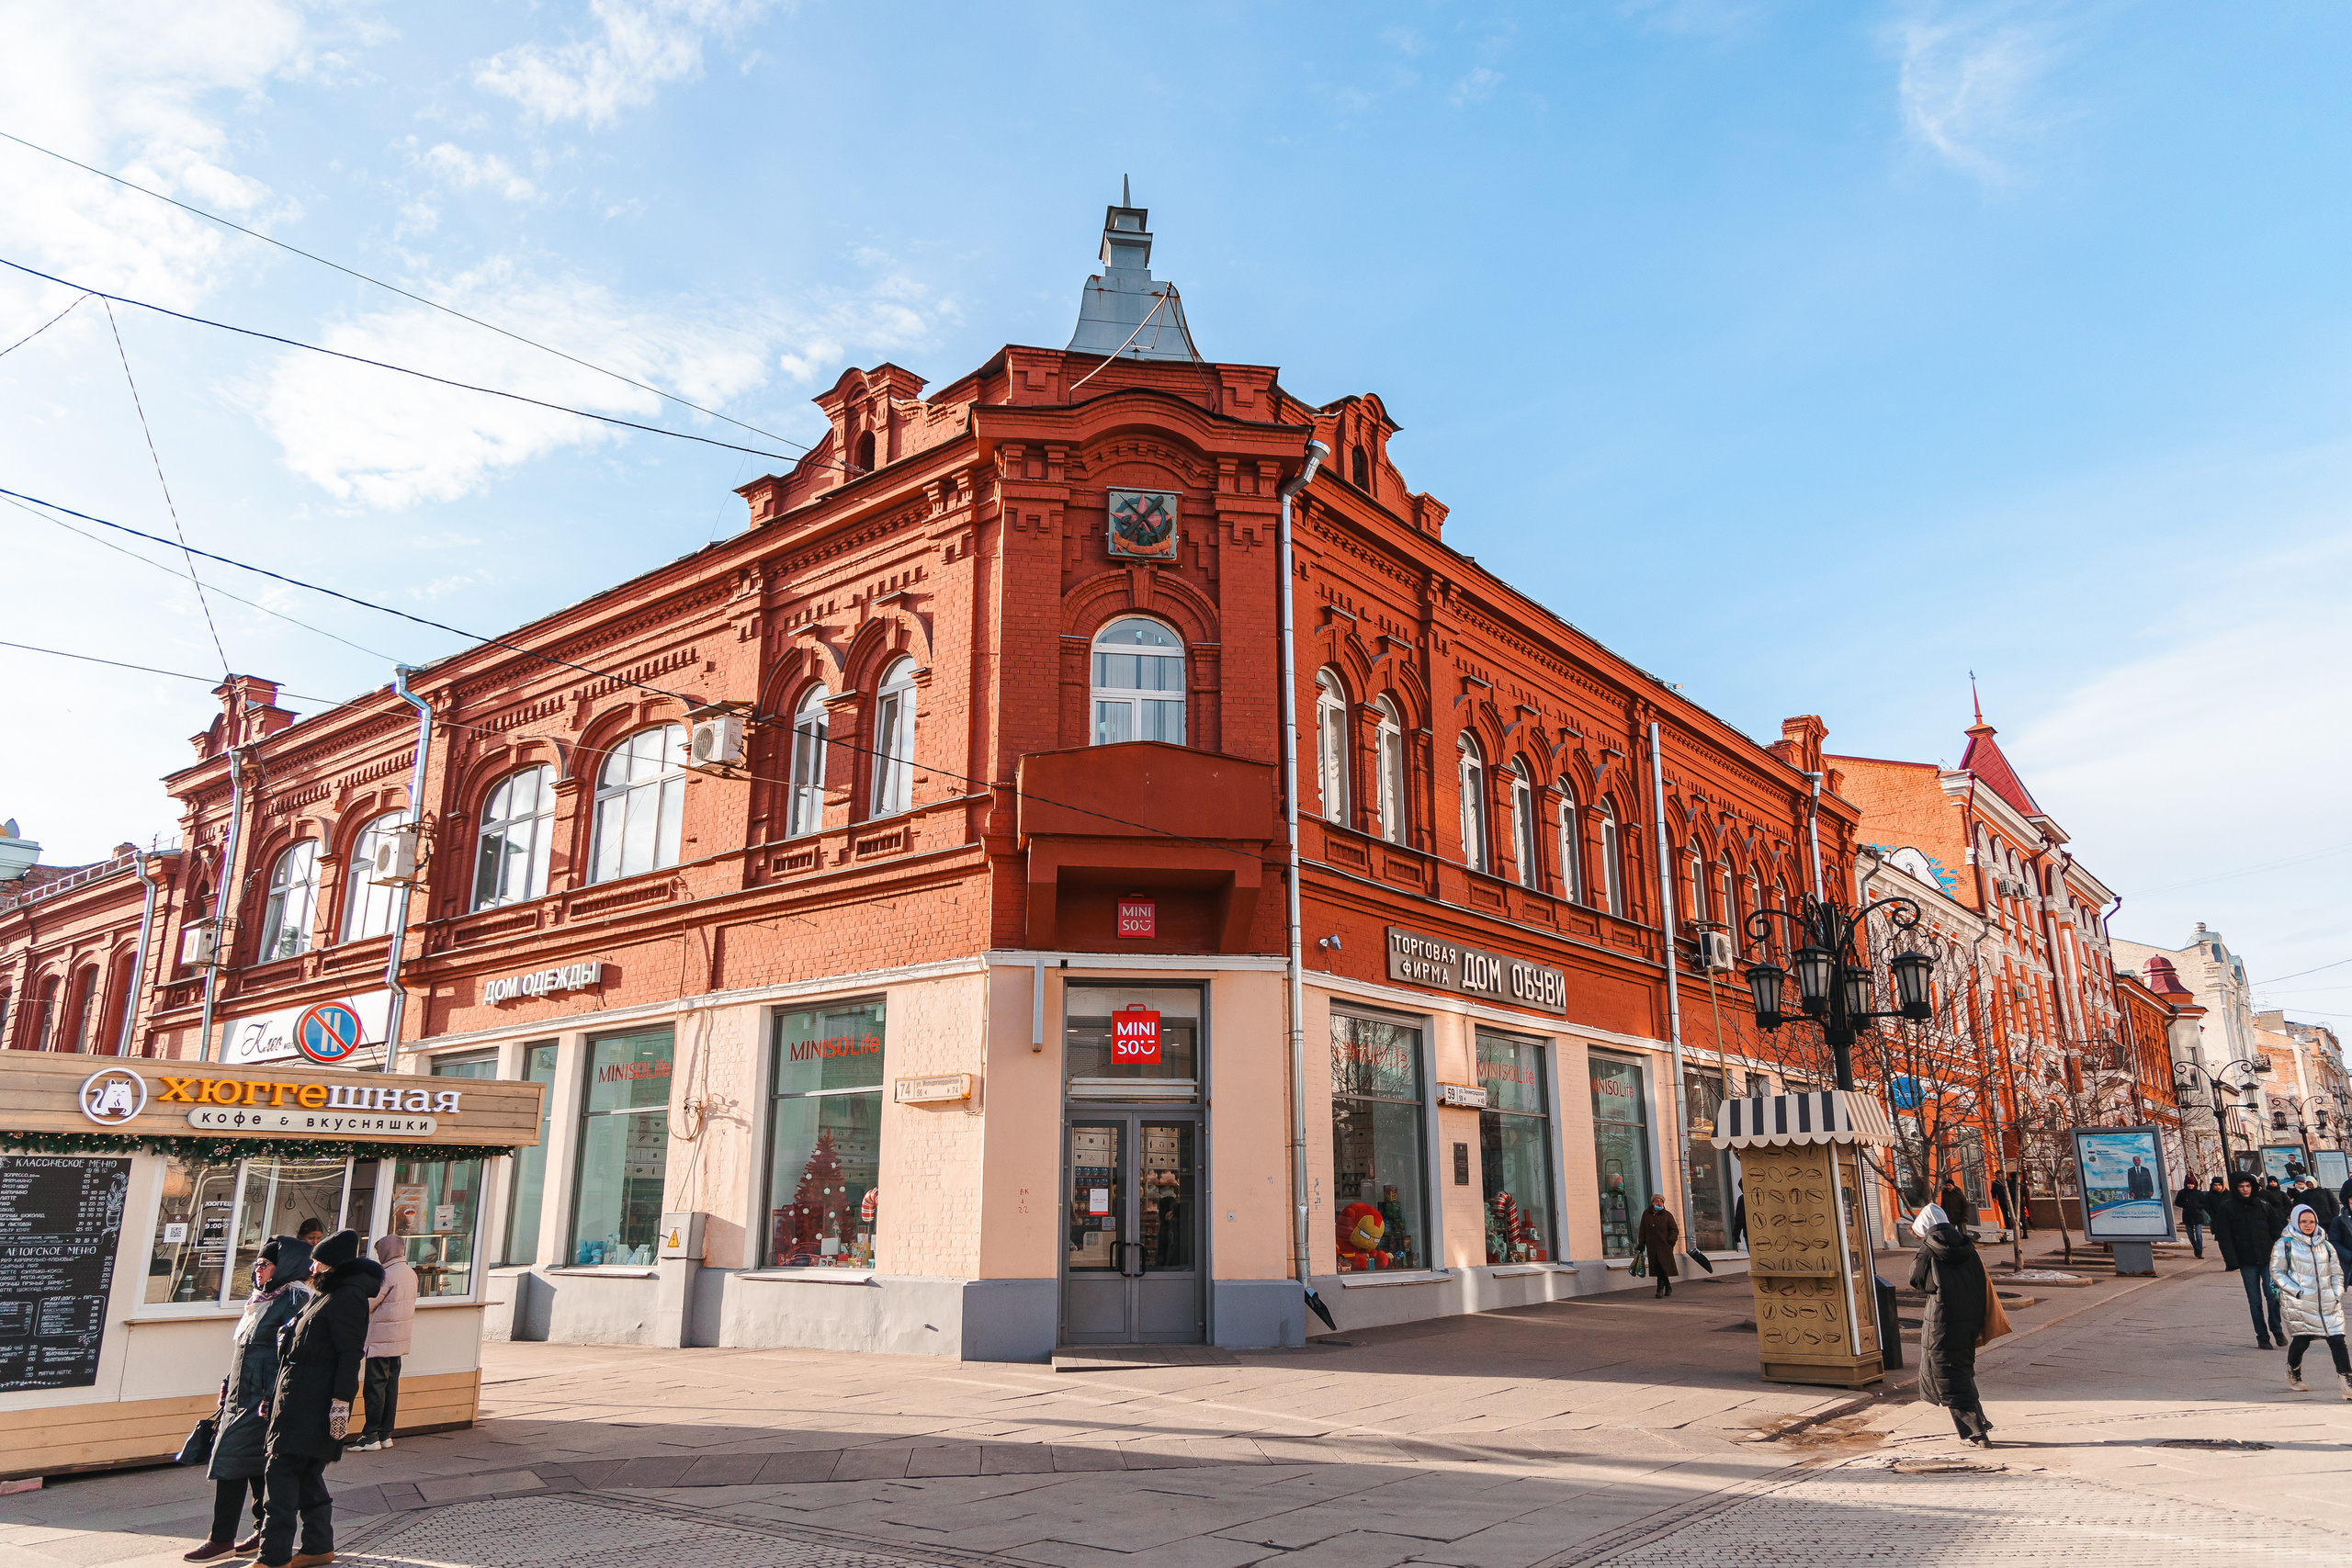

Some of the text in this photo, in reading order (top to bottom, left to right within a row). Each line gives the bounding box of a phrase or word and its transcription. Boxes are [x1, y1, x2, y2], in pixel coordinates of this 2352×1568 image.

[1122, 907, 1151, 917] MINI
[1394, 934, 1457, 965] ТОРГОВАЯ
[482, 961, 602, 1006] ДОМ ОДЕЖДЫ
[1402, 960, 1450, 985] ФИРМА
[1462, 952, 1567, 1008] ДОМ ОБУВИ
[241, 1020, 284, 1056] Клео
[1117, 1021, 1156, 1036] MINI
[156, 1076, 462, 1114] хюггешная
[899, 1082, 911, 1098] 74
[1447, 1088, 1455, 1100] 59
[202, 1111, 262, 1128] кофе
[307, 1118, 429, 1133] вкусняшки
[16, 1158, 118, 1168] КЛАССИЧЕСКОЕ МЕНЮ
[5, 1246, 97, 1257] АВТОРСКОЕ МЕНЮ
